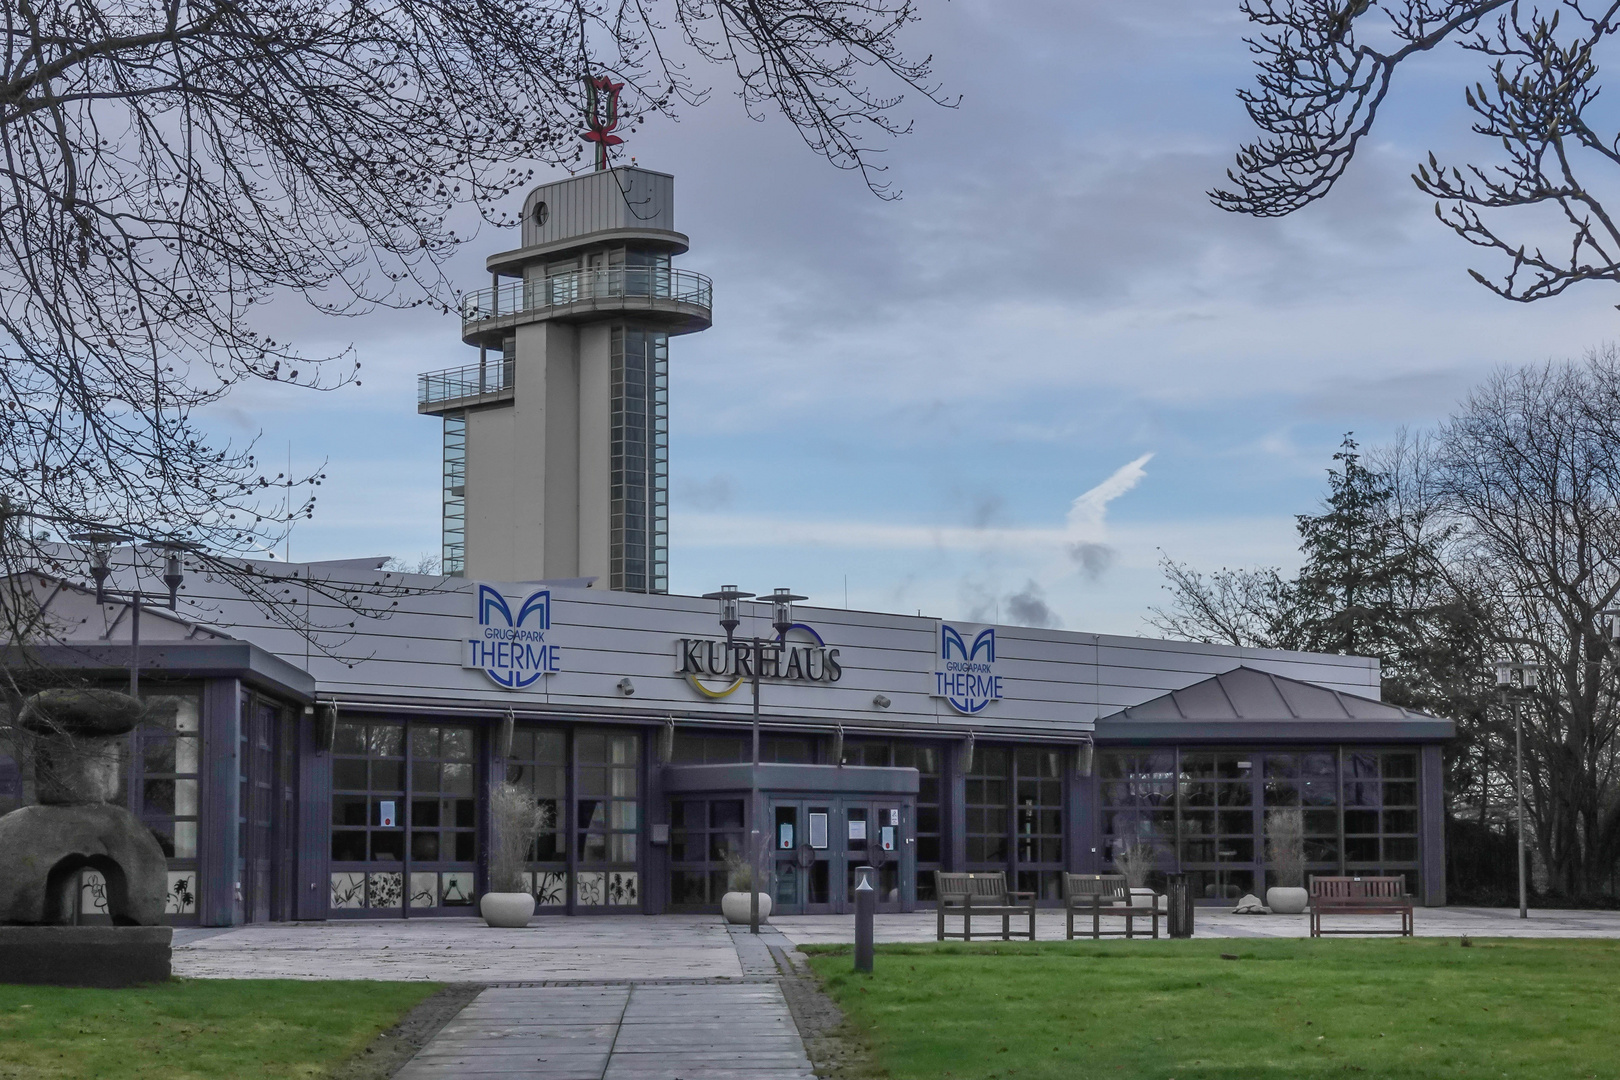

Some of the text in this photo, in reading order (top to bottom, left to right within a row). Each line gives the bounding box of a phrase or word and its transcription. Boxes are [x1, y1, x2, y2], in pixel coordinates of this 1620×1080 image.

[484, 627, 545, 643] GRUGAPARK
[468, 639, 560, 671] THERME
[678, 638, 842, 682] KURHAUS
[946, 661, 991, 674] GRUGAPARK
[935, 672, 1003, 698] THERME
